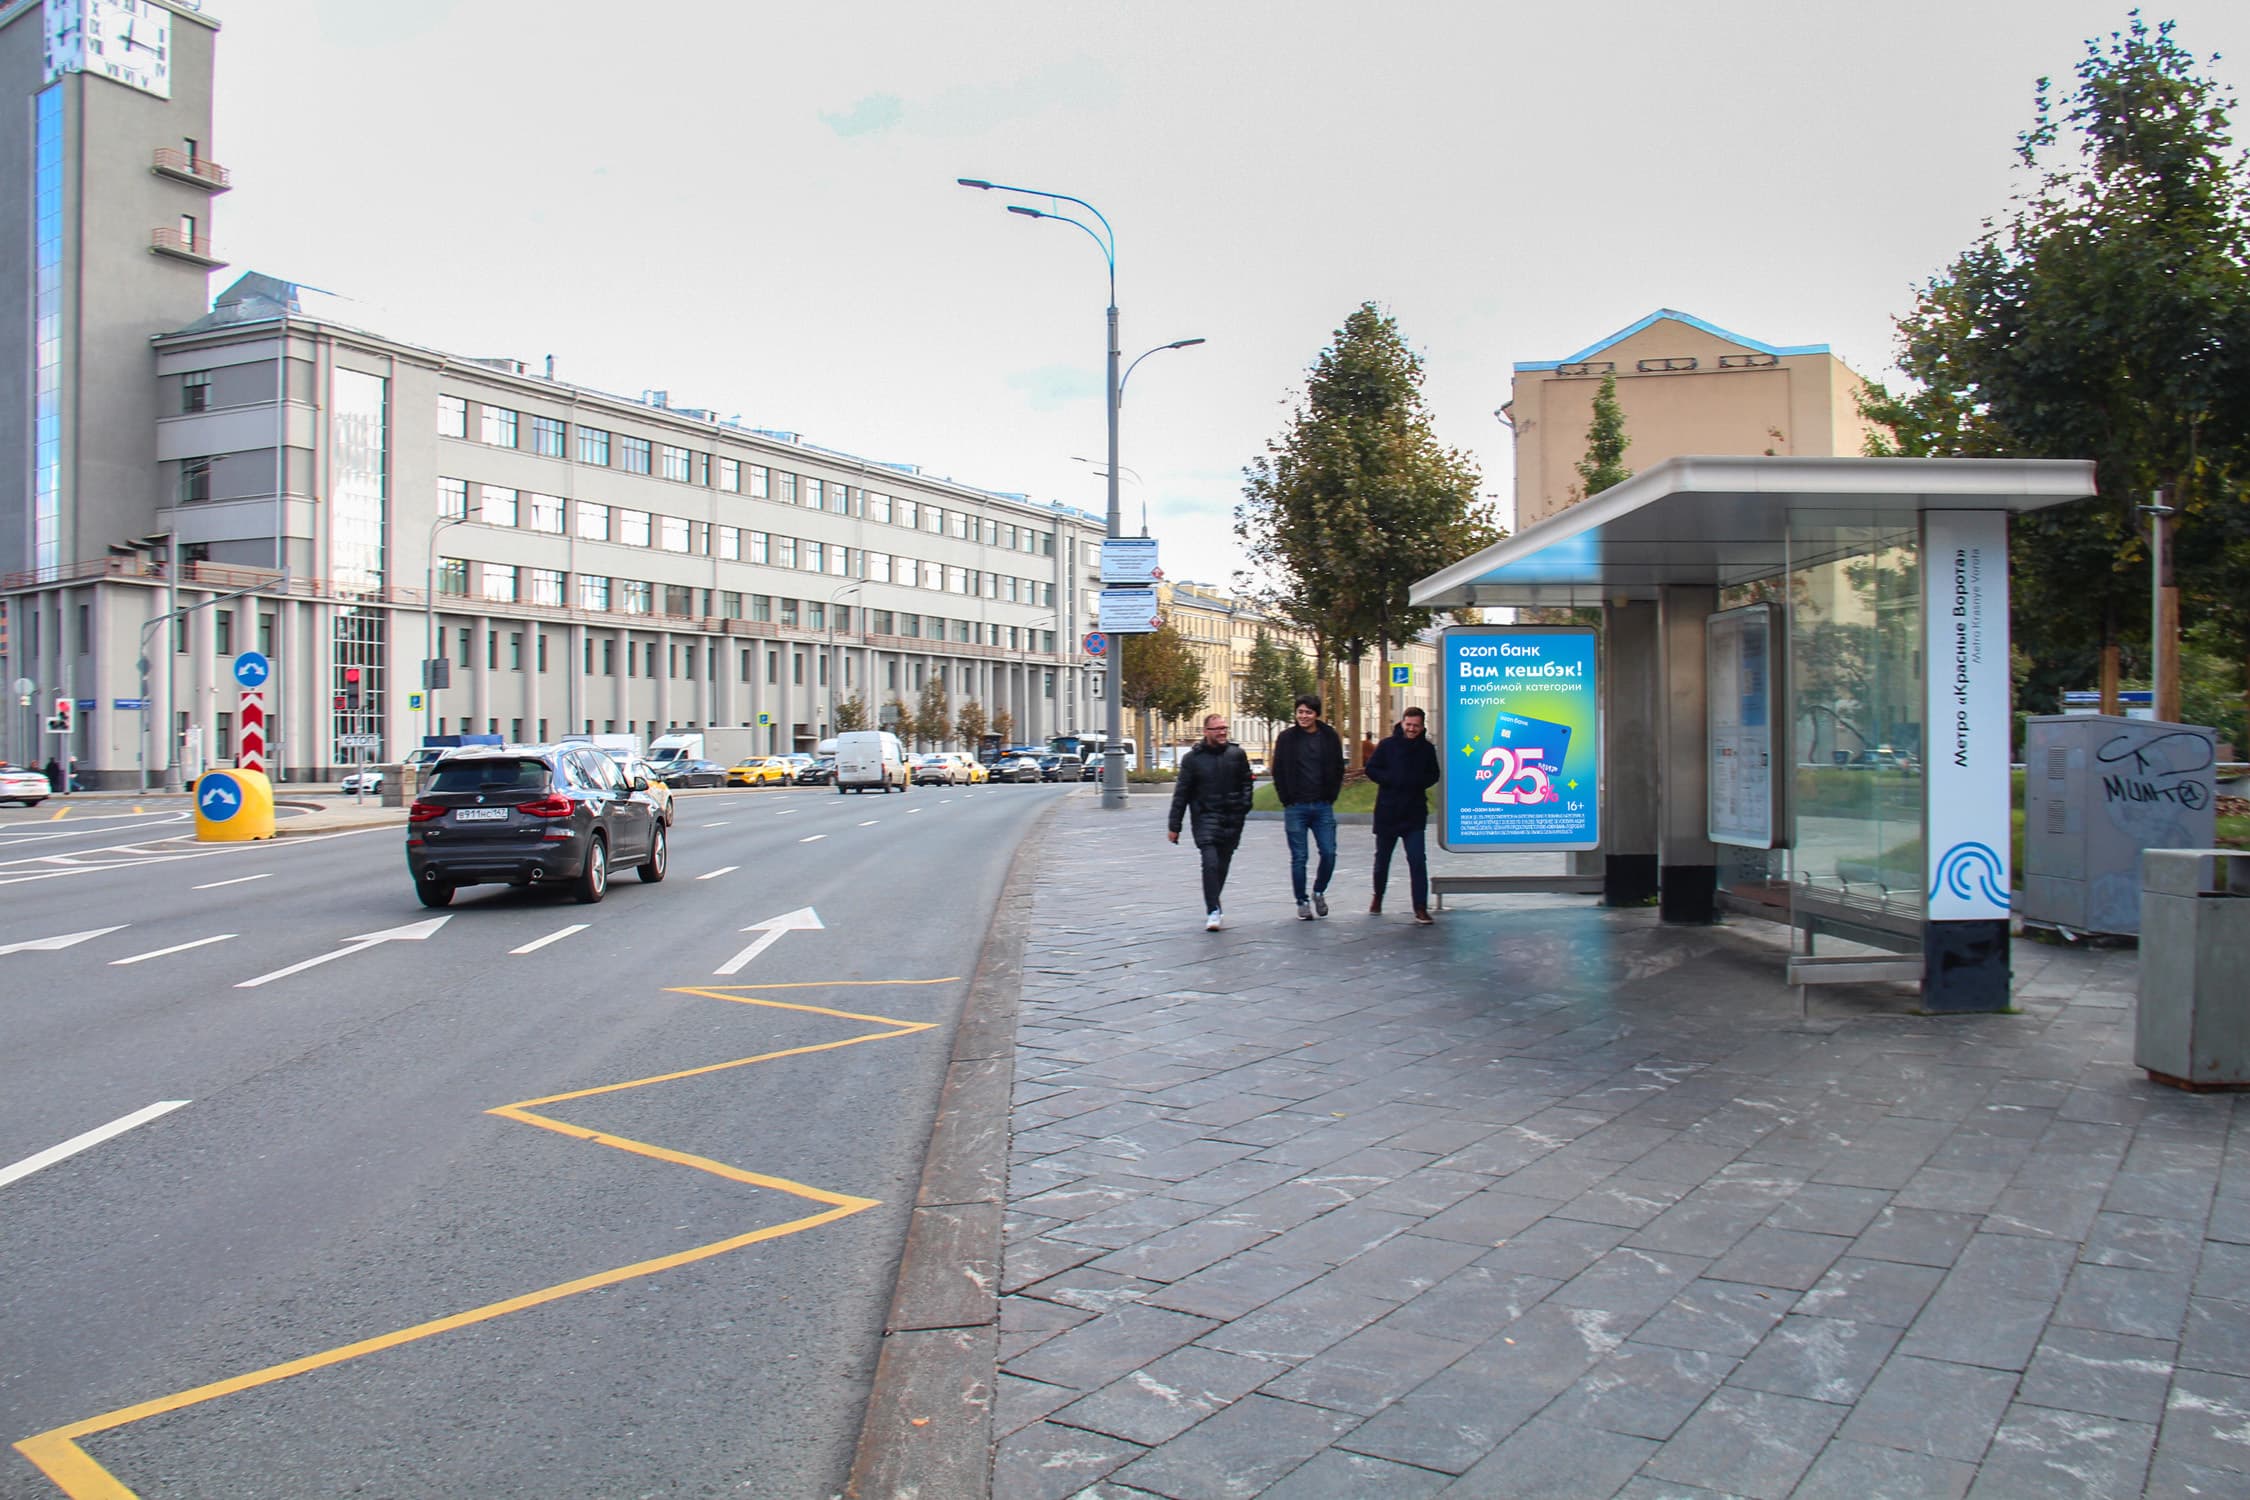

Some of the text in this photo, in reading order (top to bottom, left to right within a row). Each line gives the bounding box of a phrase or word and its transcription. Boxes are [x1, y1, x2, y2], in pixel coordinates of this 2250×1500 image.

[1971, 549, 1983, 664] Metro Krasnye Vorota
[1459, 643, 1541, 657] ozon банк
[1952, 549, 1970, 768] Метро «Красные Ворота»
[1460, 661, 1583, 678] Вам кешбэк!
[1460, 682, 1582, 693] в любимой категории
[1460, 697, 1506, 707] покупок
[344, 735, 376, 745] СТОП
[1475, 769, 1493, 780] до
[1567, 801, 1584, 811] 16+
